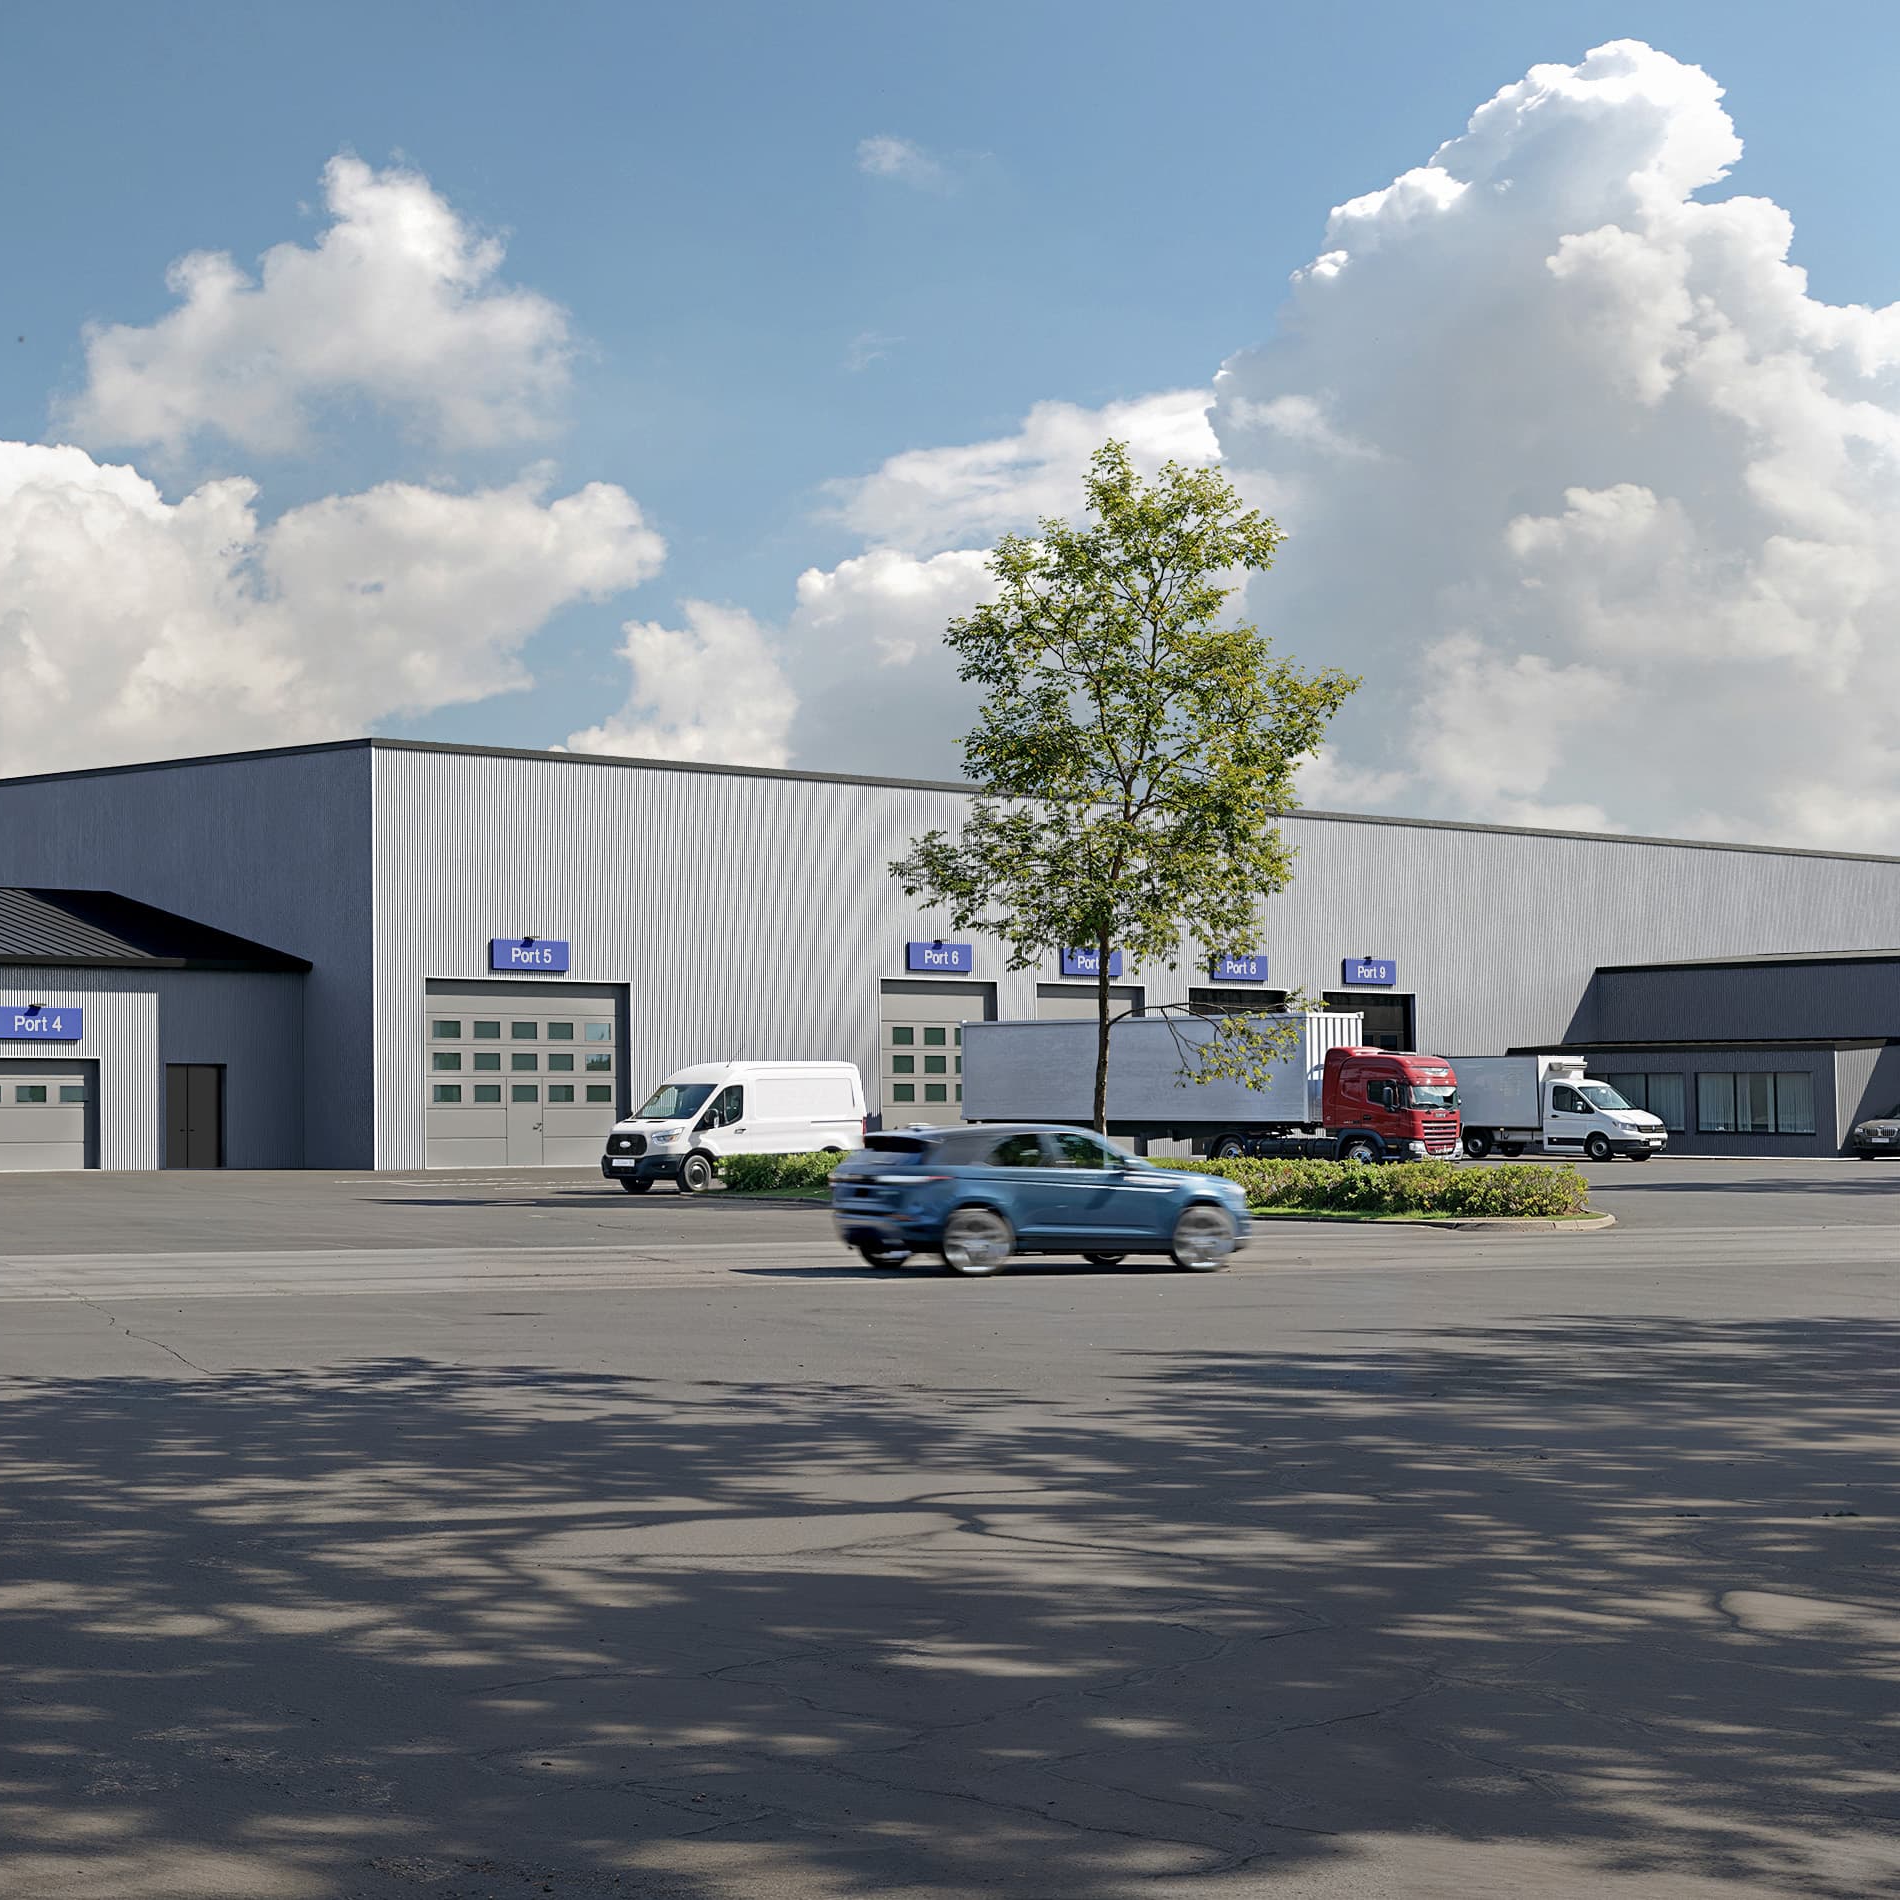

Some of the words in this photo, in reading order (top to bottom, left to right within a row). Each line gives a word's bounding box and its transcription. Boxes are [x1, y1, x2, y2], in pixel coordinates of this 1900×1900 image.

[511, 947, 541, 964] Port
[543, 948, 552, 964] 5
[924, 949, 949, 965] Port
[951, 950, 960, 965] 6
[1077, 955, 1100, 970] Port
[1226, 959, 1247, 974] Port
[1249, 961, 1257, 975] 8
[1357, 965, 1378, 980] Port
[1379, 966, 1386, 980] 9
[14, 1016, 48, 1032] Port
[52, 1016, 63, 1032] 4
